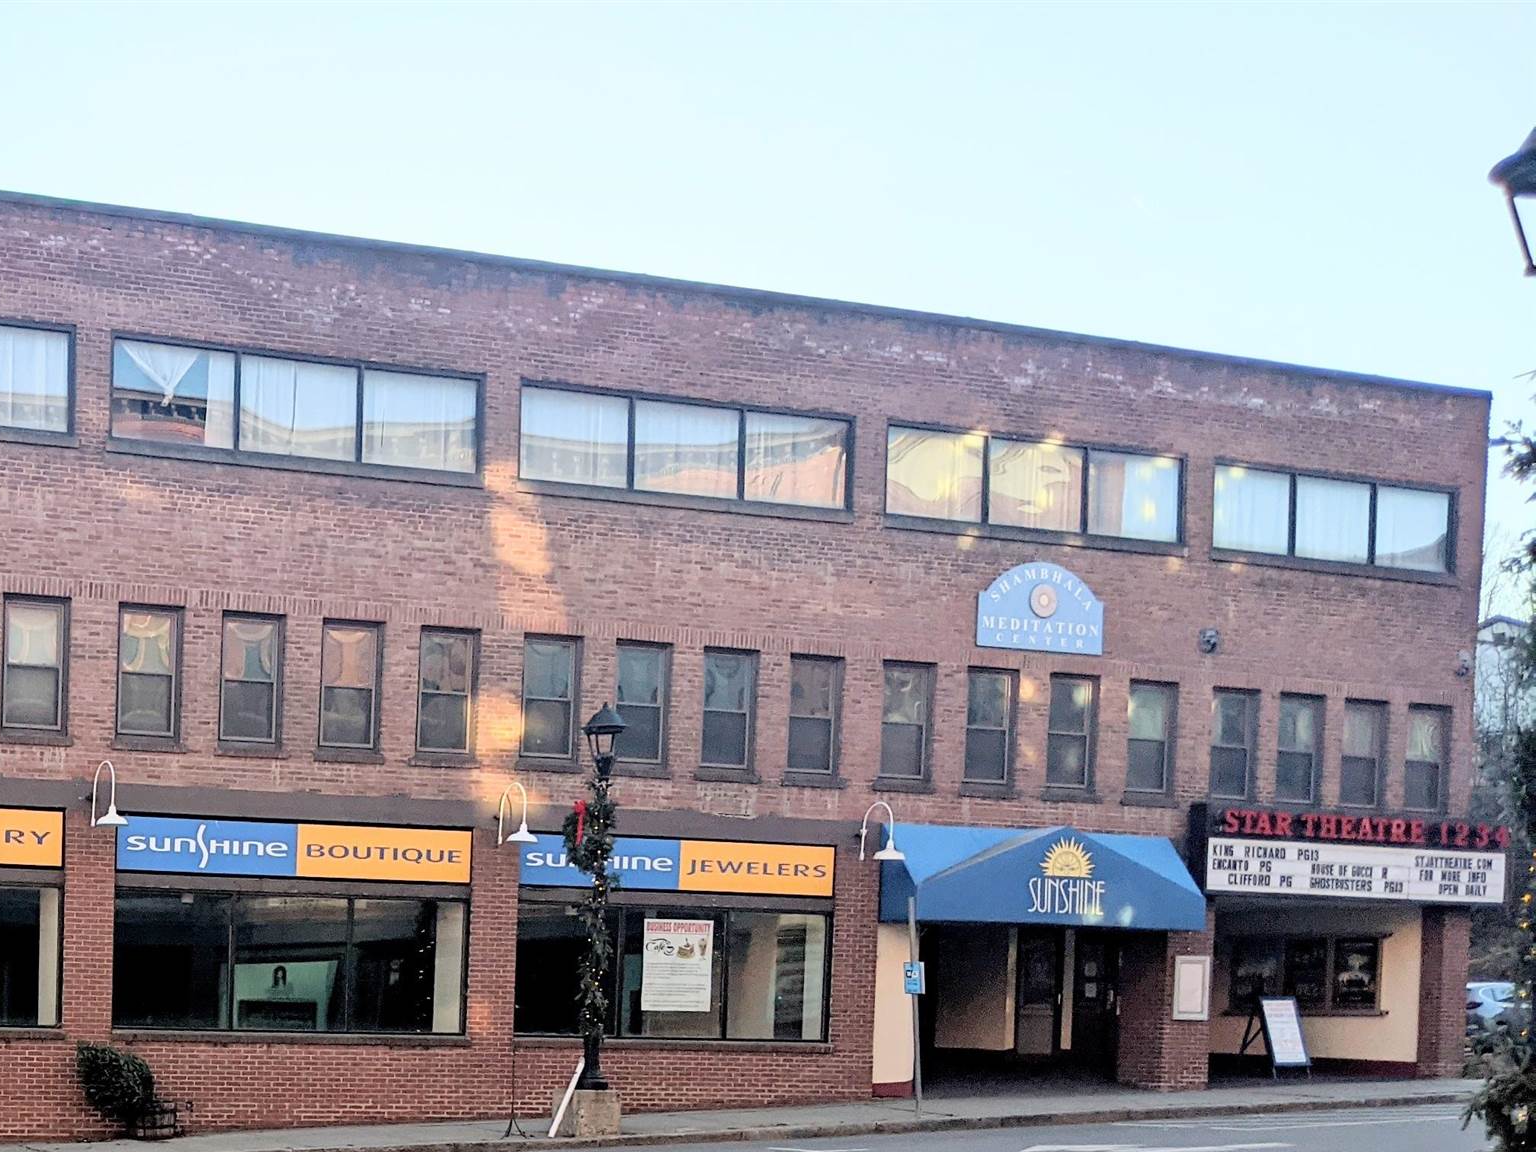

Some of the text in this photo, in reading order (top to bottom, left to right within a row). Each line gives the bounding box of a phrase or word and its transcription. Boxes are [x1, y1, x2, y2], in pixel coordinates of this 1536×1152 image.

[990, 568, 1092, 611] SHAMBHALA
[982, 615, 1099, 637] MEDITATION
[995, 632, 1084, 648] CENTER
[1223, 809, 1293, 836] STAR
[1300, 813, 1425, 844] THEATRE
[306, 843, 463, 864] BOUTIQUE
[1212, 845, 1319, 861] KING RICHARD PG13
[686, 858, 827, 878] JEWELERS
[1212, 859, 1272, 872] ENCANTO PG
[1311, 863, 1388, 879] HOUSE OF GUCCI R
[1228, 874, 1293, 887] CLIFFORD PG
[1419, 870, 1486, 883] FOR MORE INFO
[1309, 877, 1403, 893] GHOSTBUSTERS PG13
[1438, 884, 1488, 896] OPEN DAILY
[1027, 877, 1106, 916] SUNSHINE
